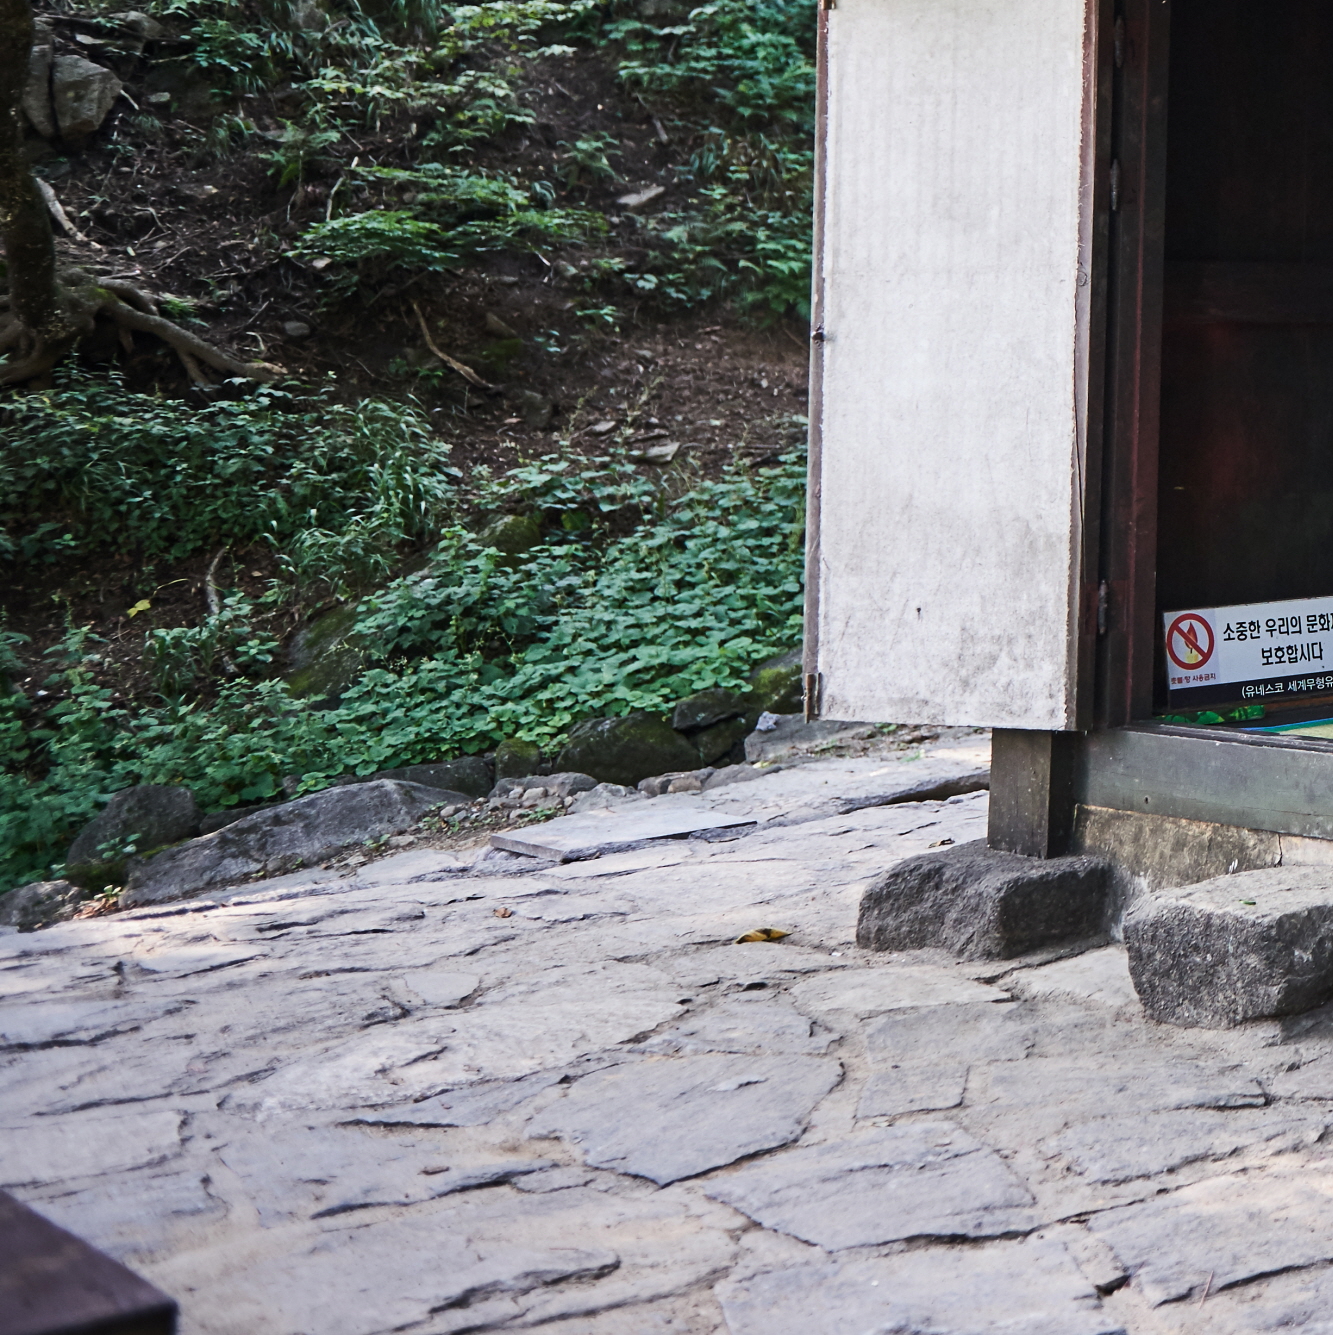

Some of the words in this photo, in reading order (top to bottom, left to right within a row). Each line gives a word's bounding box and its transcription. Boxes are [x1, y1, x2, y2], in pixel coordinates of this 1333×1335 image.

[1223, 620, 1261, 641] 소중한
[1265, 616, 1302, 637] 우리의
[1261, 641, 1324, 666] 보호합시다
[1192, 672, 1216, 682] 사용금지
[1241, 682, 1285, 699] (유네스코
